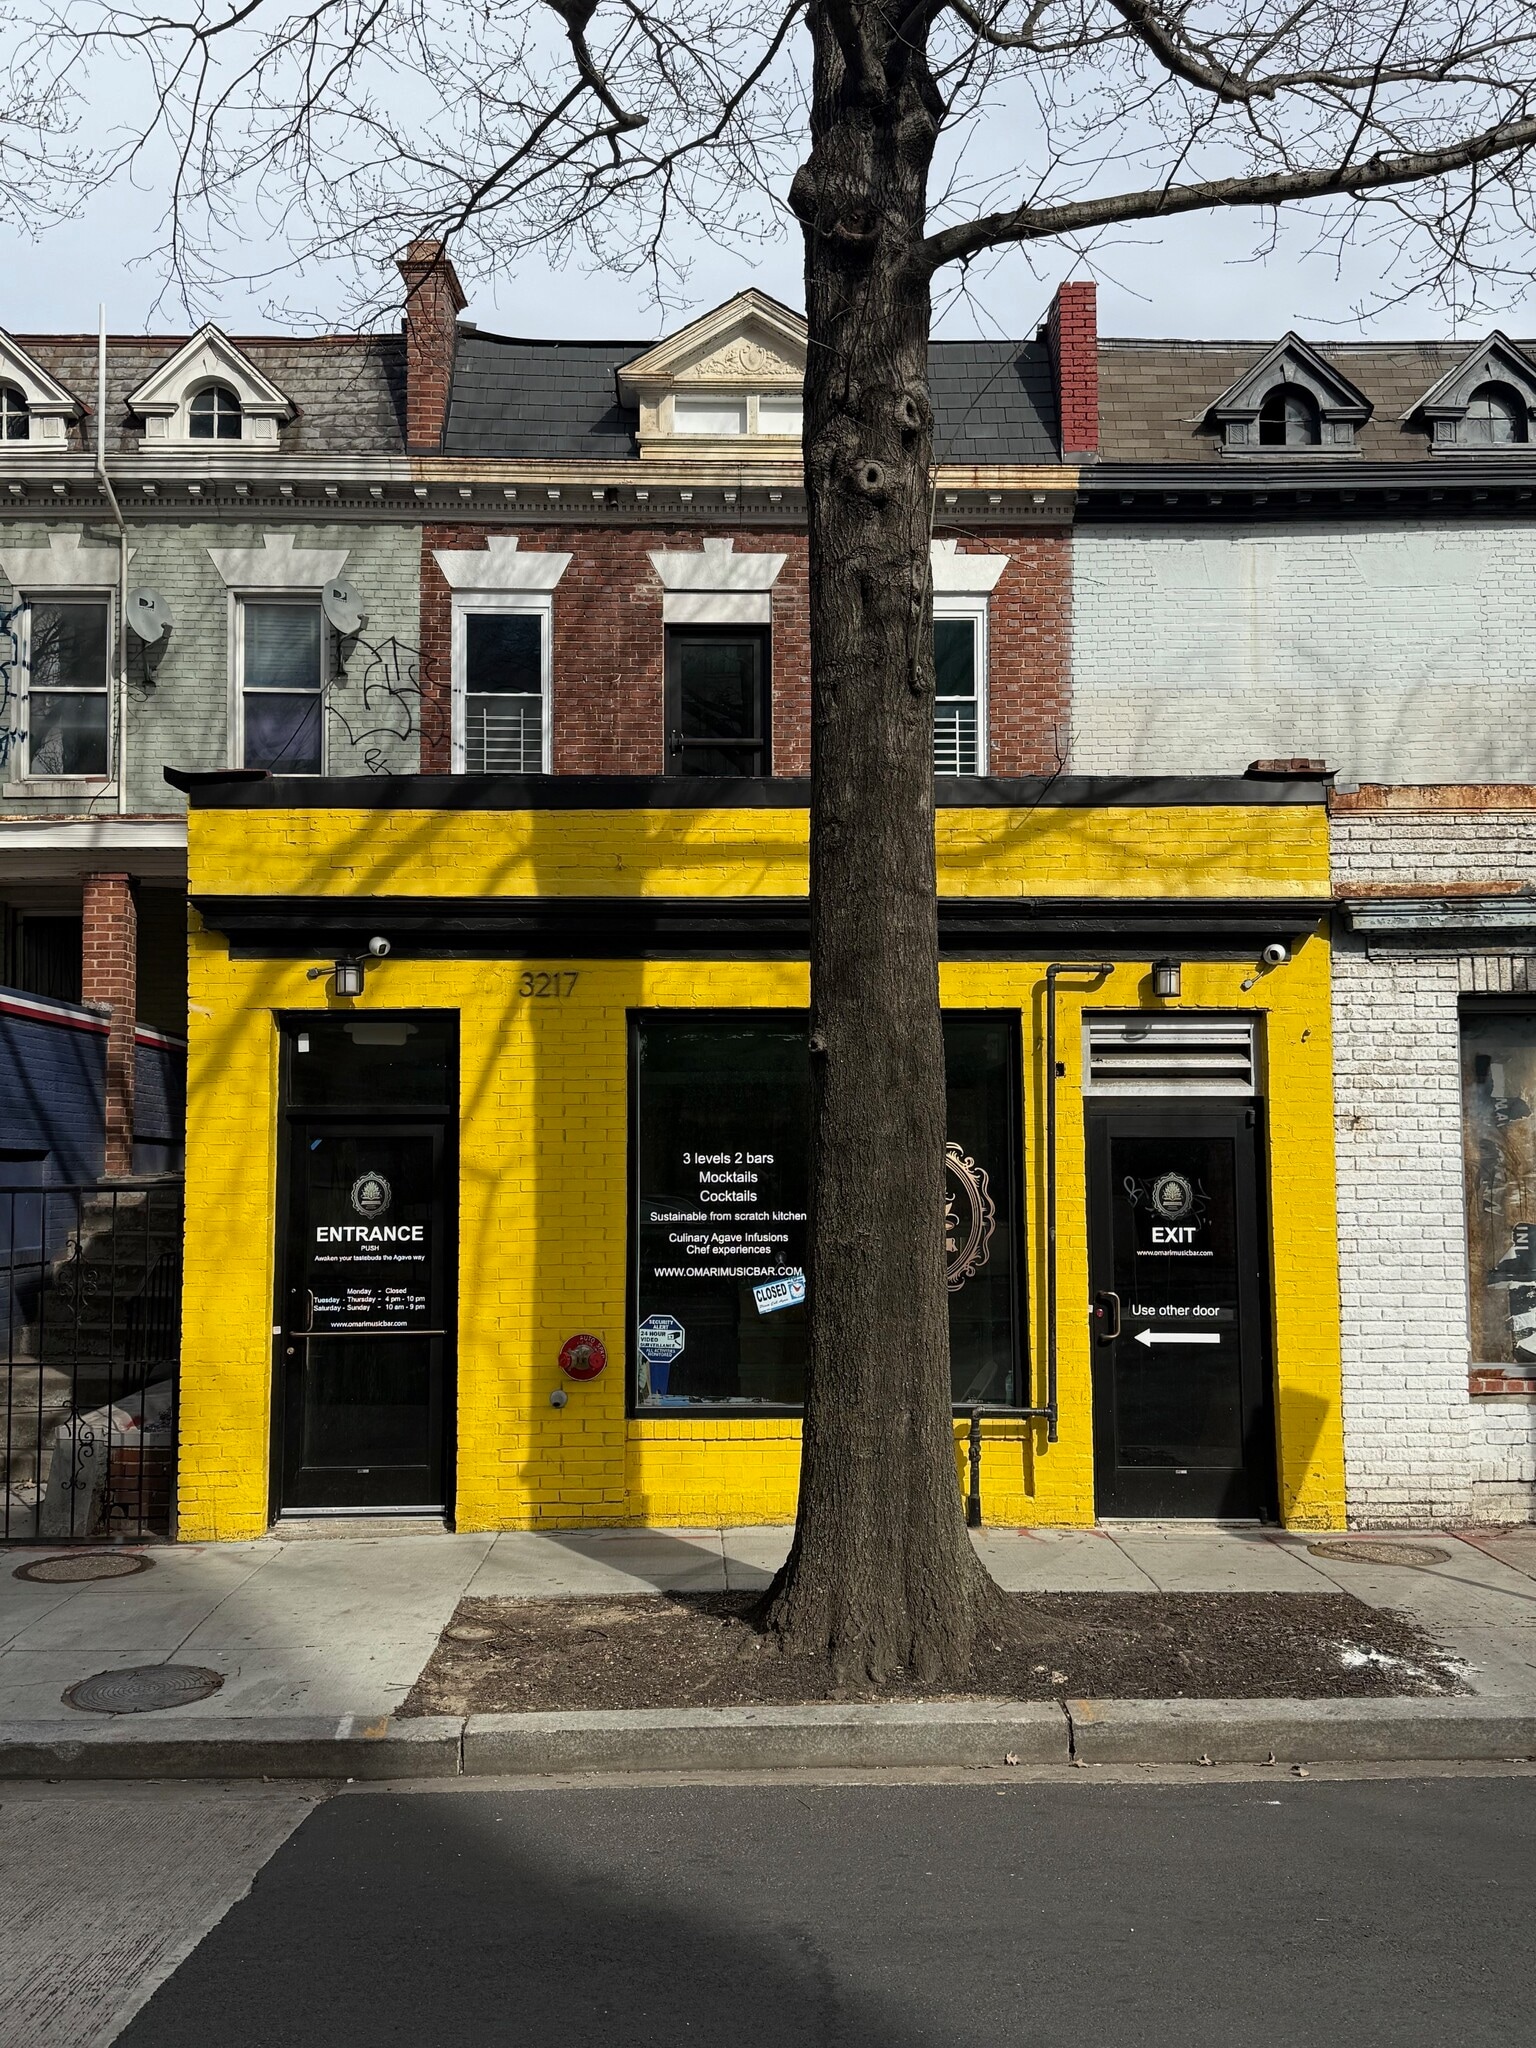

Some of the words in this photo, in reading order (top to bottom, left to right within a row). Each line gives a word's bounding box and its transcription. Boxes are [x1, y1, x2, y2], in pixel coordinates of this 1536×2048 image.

[519, 972, 579, 997] 3217
[682, 1152, 691, 1164] 3
[694, 1152, 731, 1164] levels
[734, 1152, 743, 1164] 2
[746, 1152, 774, 1164] bars
[699, 1171, 758, 1183] Mocktails
[700, 1190, 758, 1202] Cocktails
[650, 1211, 707, 1222] Sustainable
[709, 1211, 732, 1221] from
[734, 1211, 770, 1221] scratch
[772, 1211, 807, 1221] kitchen
[316, 1226, 424, 1242] ENTRANCE
[669, 1233, 709, 1244] Culinary
[711, 1233, 742, 1244] Agave
[744, 1233, 789, 1243] Infusions
[1152, 1227, 1197, 1243] EXIT
[686, 1244, 711, 1255] Chef
[712, 1245, 771, 1256] experiences
[654, 1267, 802, 1277] WWW.OMARIMUSICBAR.COM
[346, 1288, 372, 1296] Monday
[755, 1283, 788, 1303] CLOSED
[313, 1296, 341, 1304] Tuesday
[347, 1296, 377, 1304] Thursday
[313, 1304, 341, 1312] Saturday
[346, 1304, 371, 1312] Sunday
[1132, 1305, 1156, 1316] Use
[1158, 1305, 1190, 1316] other
[1193, 1305, 1220, 1316] door
[330, 1320, 408, 1328] www.omarimusicbar.com
